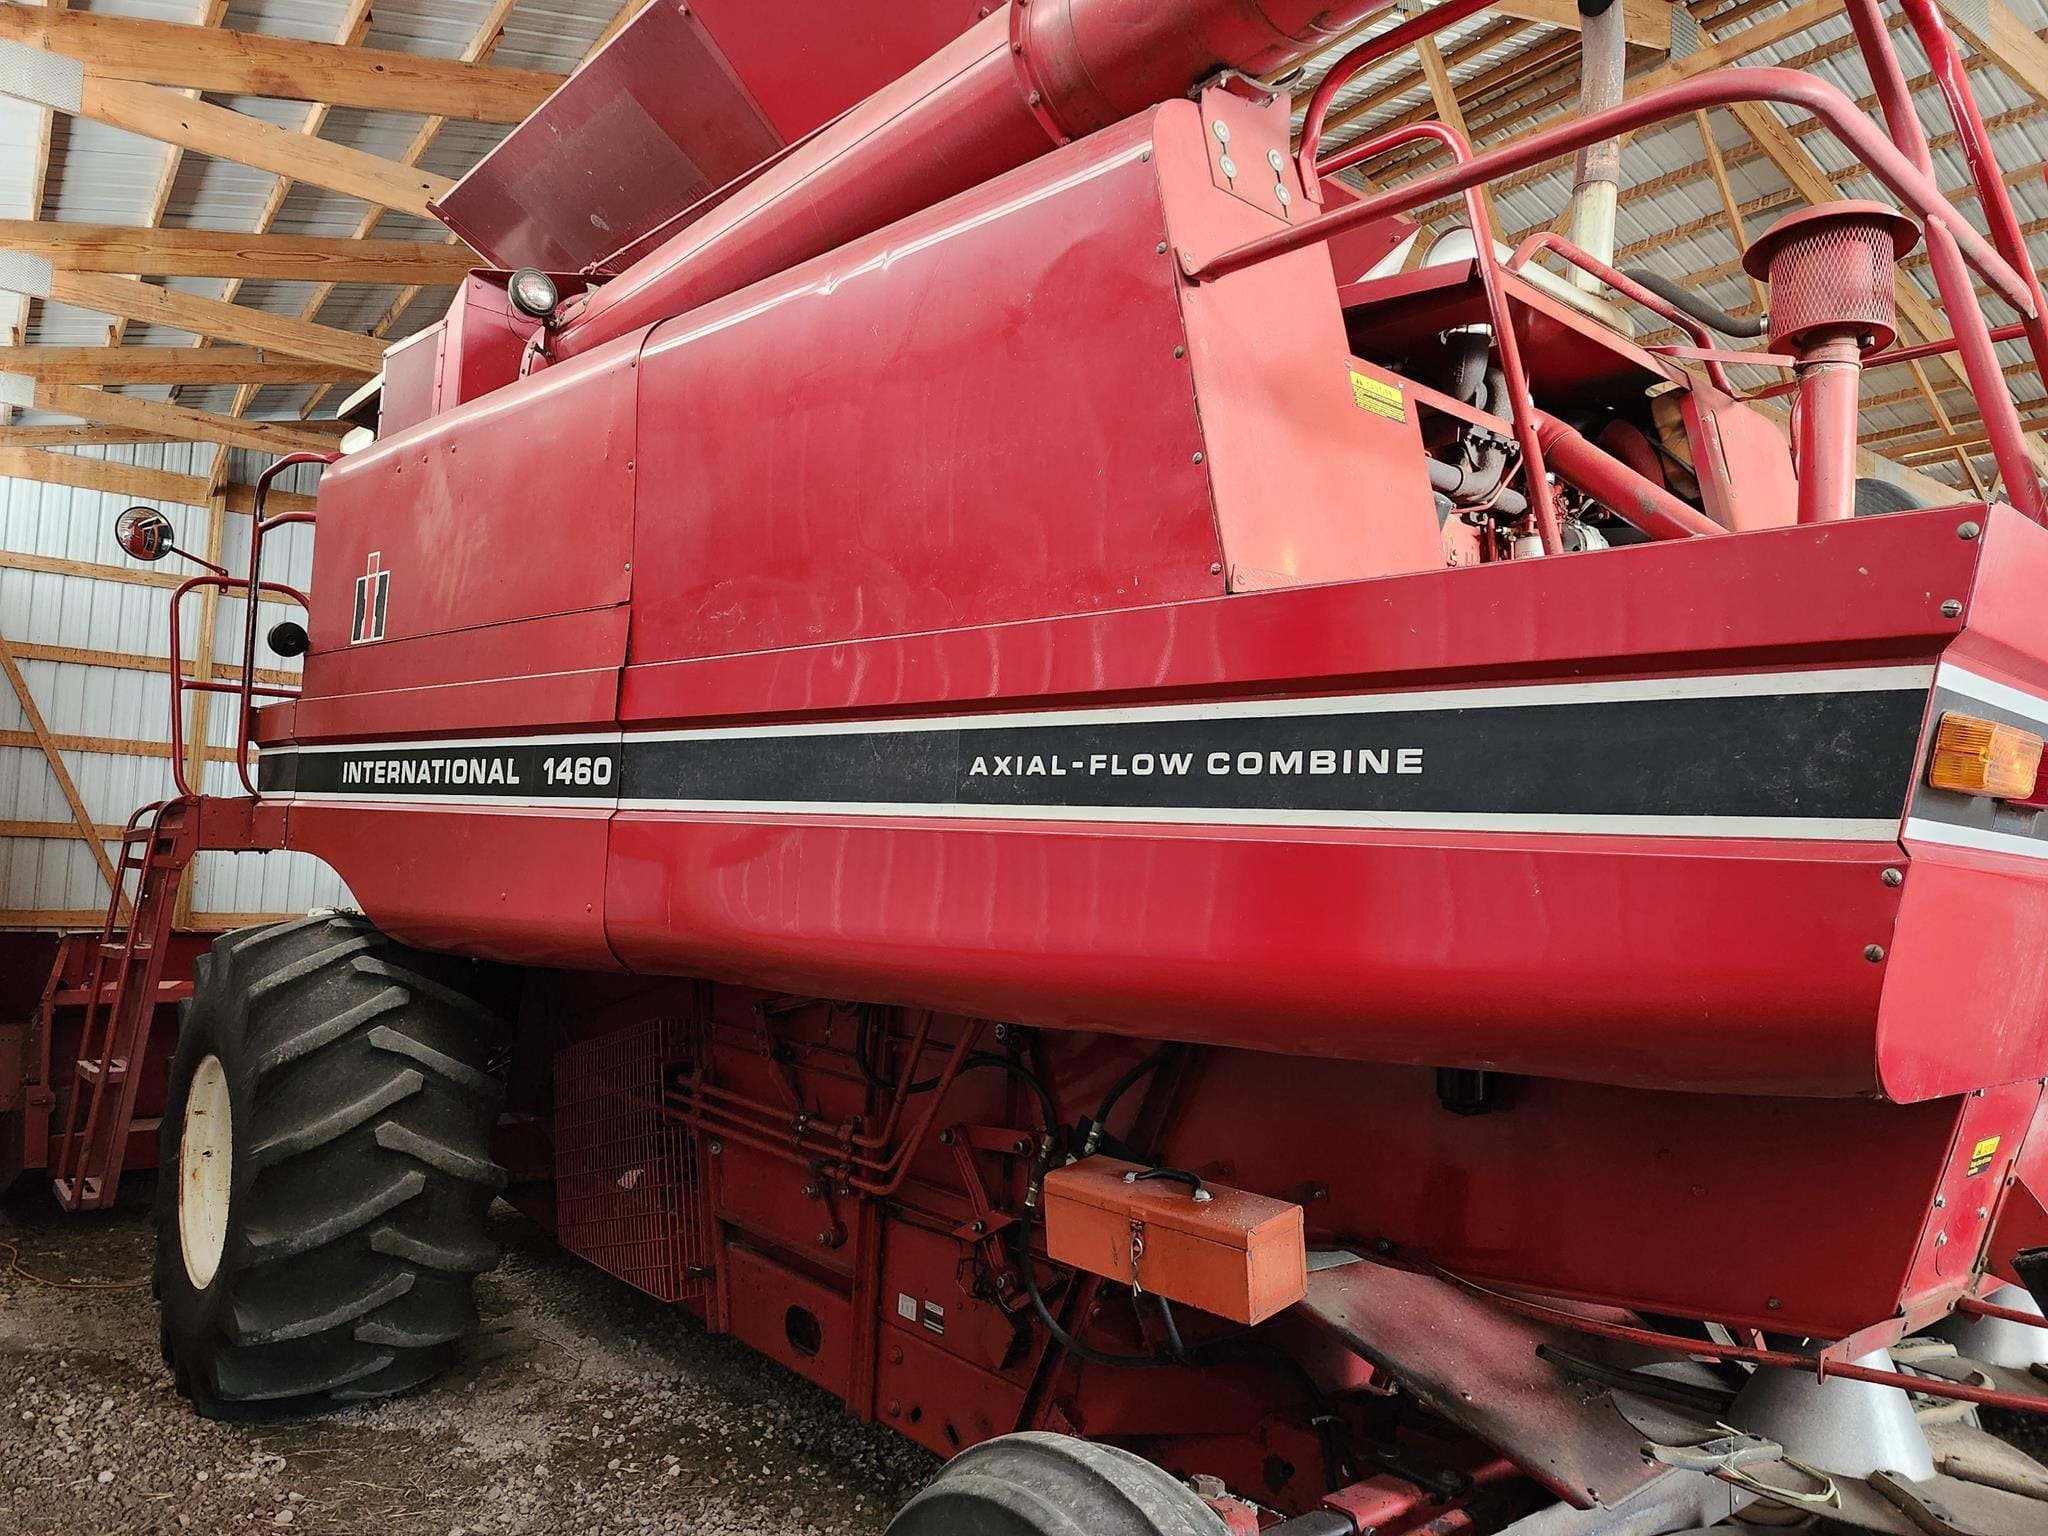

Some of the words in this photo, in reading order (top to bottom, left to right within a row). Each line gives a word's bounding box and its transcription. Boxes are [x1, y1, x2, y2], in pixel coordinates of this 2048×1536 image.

[342, 758, 520, 785] INTERNATIONAL
[542, 756, 612, 786] 1460
[969, 752, 1193, 776] AXIAL-FLOW
[1207, 748, 1424, 775] COMBINE
